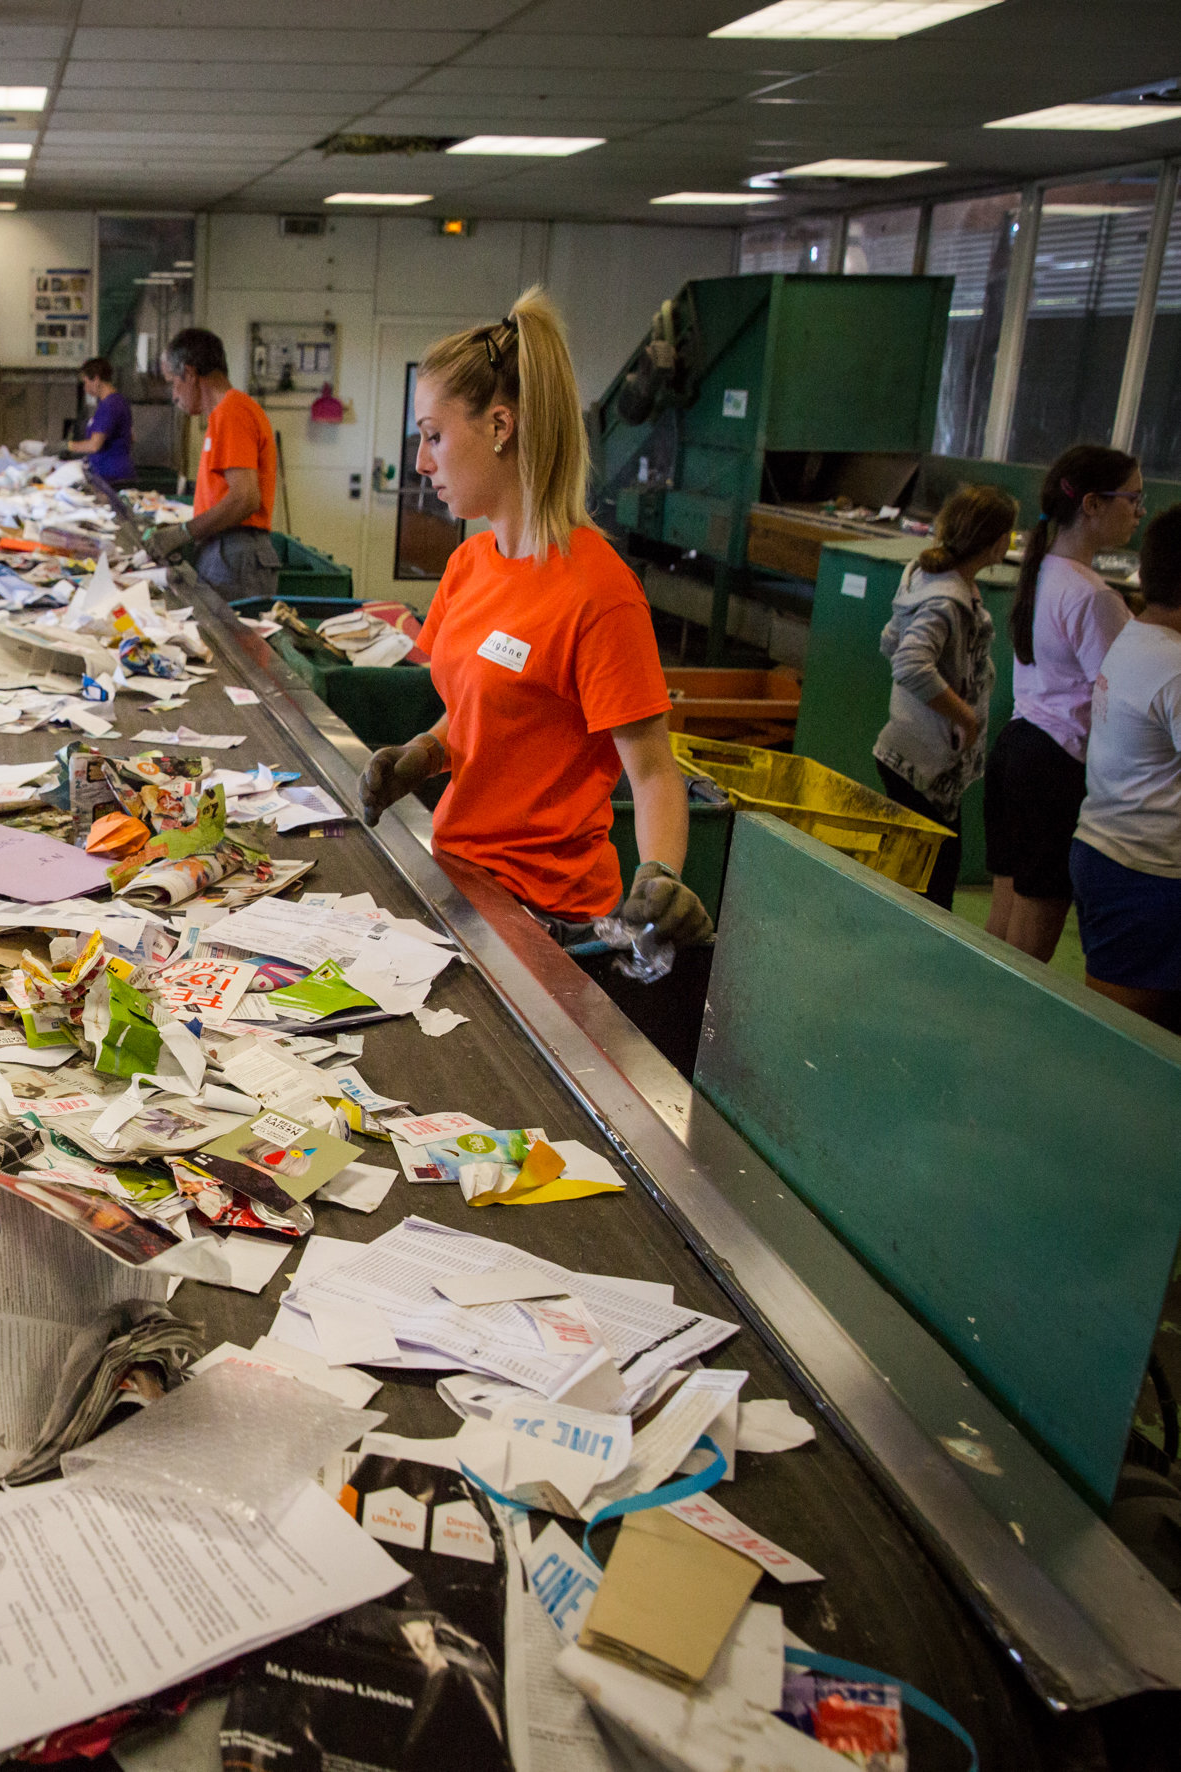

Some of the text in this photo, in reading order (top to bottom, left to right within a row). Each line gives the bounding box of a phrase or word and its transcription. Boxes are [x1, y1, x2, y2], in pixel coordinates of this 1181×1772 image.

[50, 1098, 91, 1114] CINE
[402, 1115, 472, 1137] CINE 32
[371, 1513, 417, 1532] Ultra HD
[388, 1507, 403, 1518] TV
[679, 1503, 791, 1566] CINE 32
[531, 1552, 599, 1630] CINE
[265, 1660, 415, 1710] Ma Nouvelle Livebox
